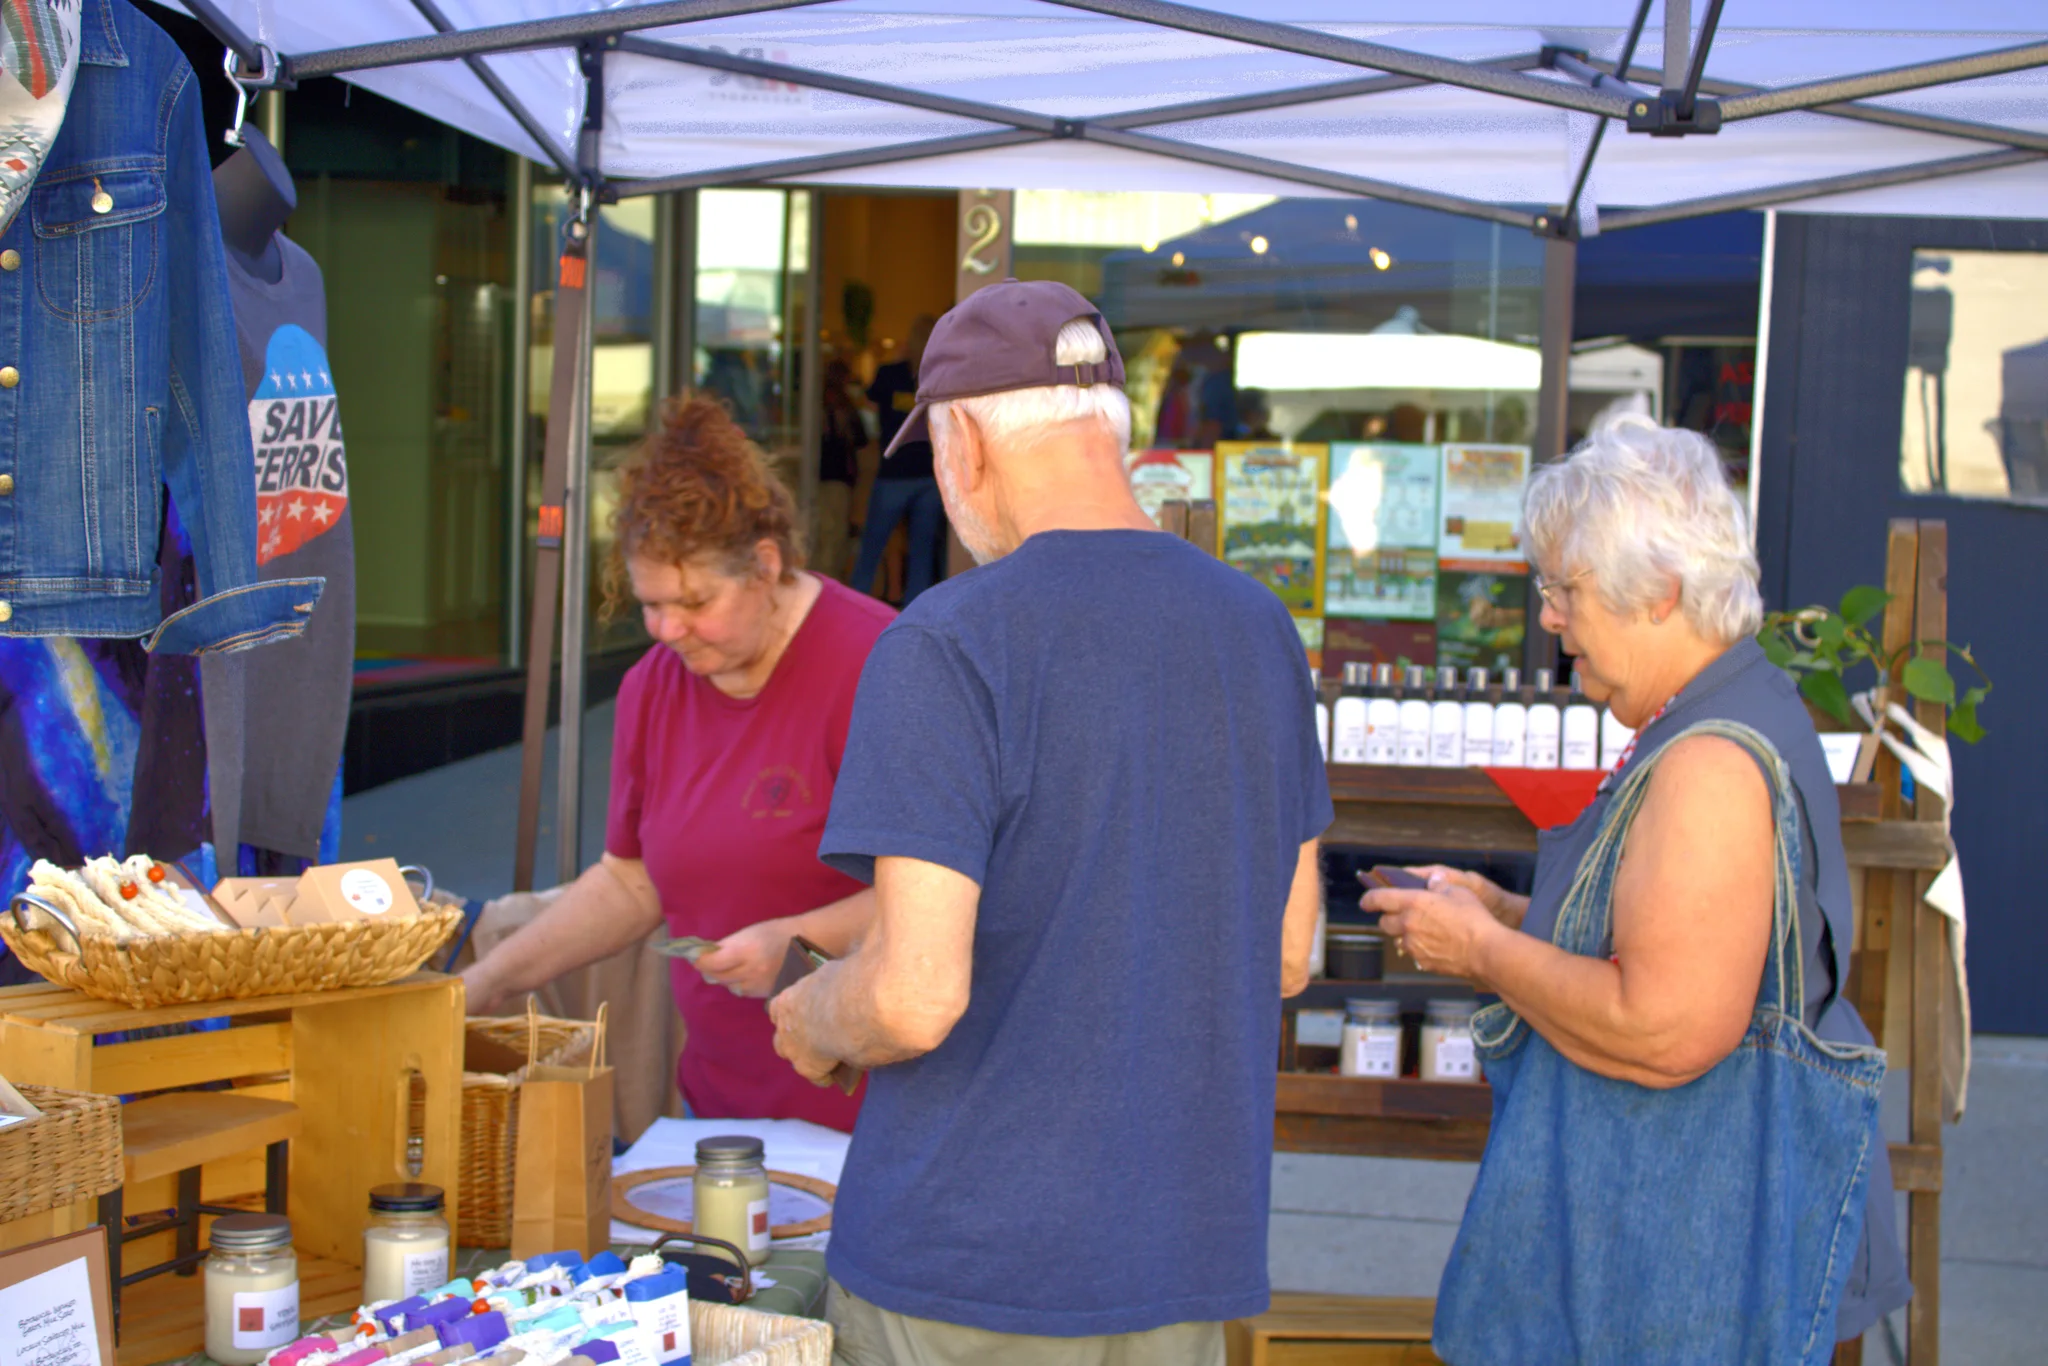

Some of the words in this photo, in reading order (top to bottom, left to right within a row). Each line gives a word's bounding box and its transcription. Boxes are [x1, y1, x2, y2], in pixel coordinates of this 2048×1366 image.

[961, 204, 1001, 275] 2
[261, 398, 343, 444] SAVE
[255, 443, 345, 491] FERRIS
